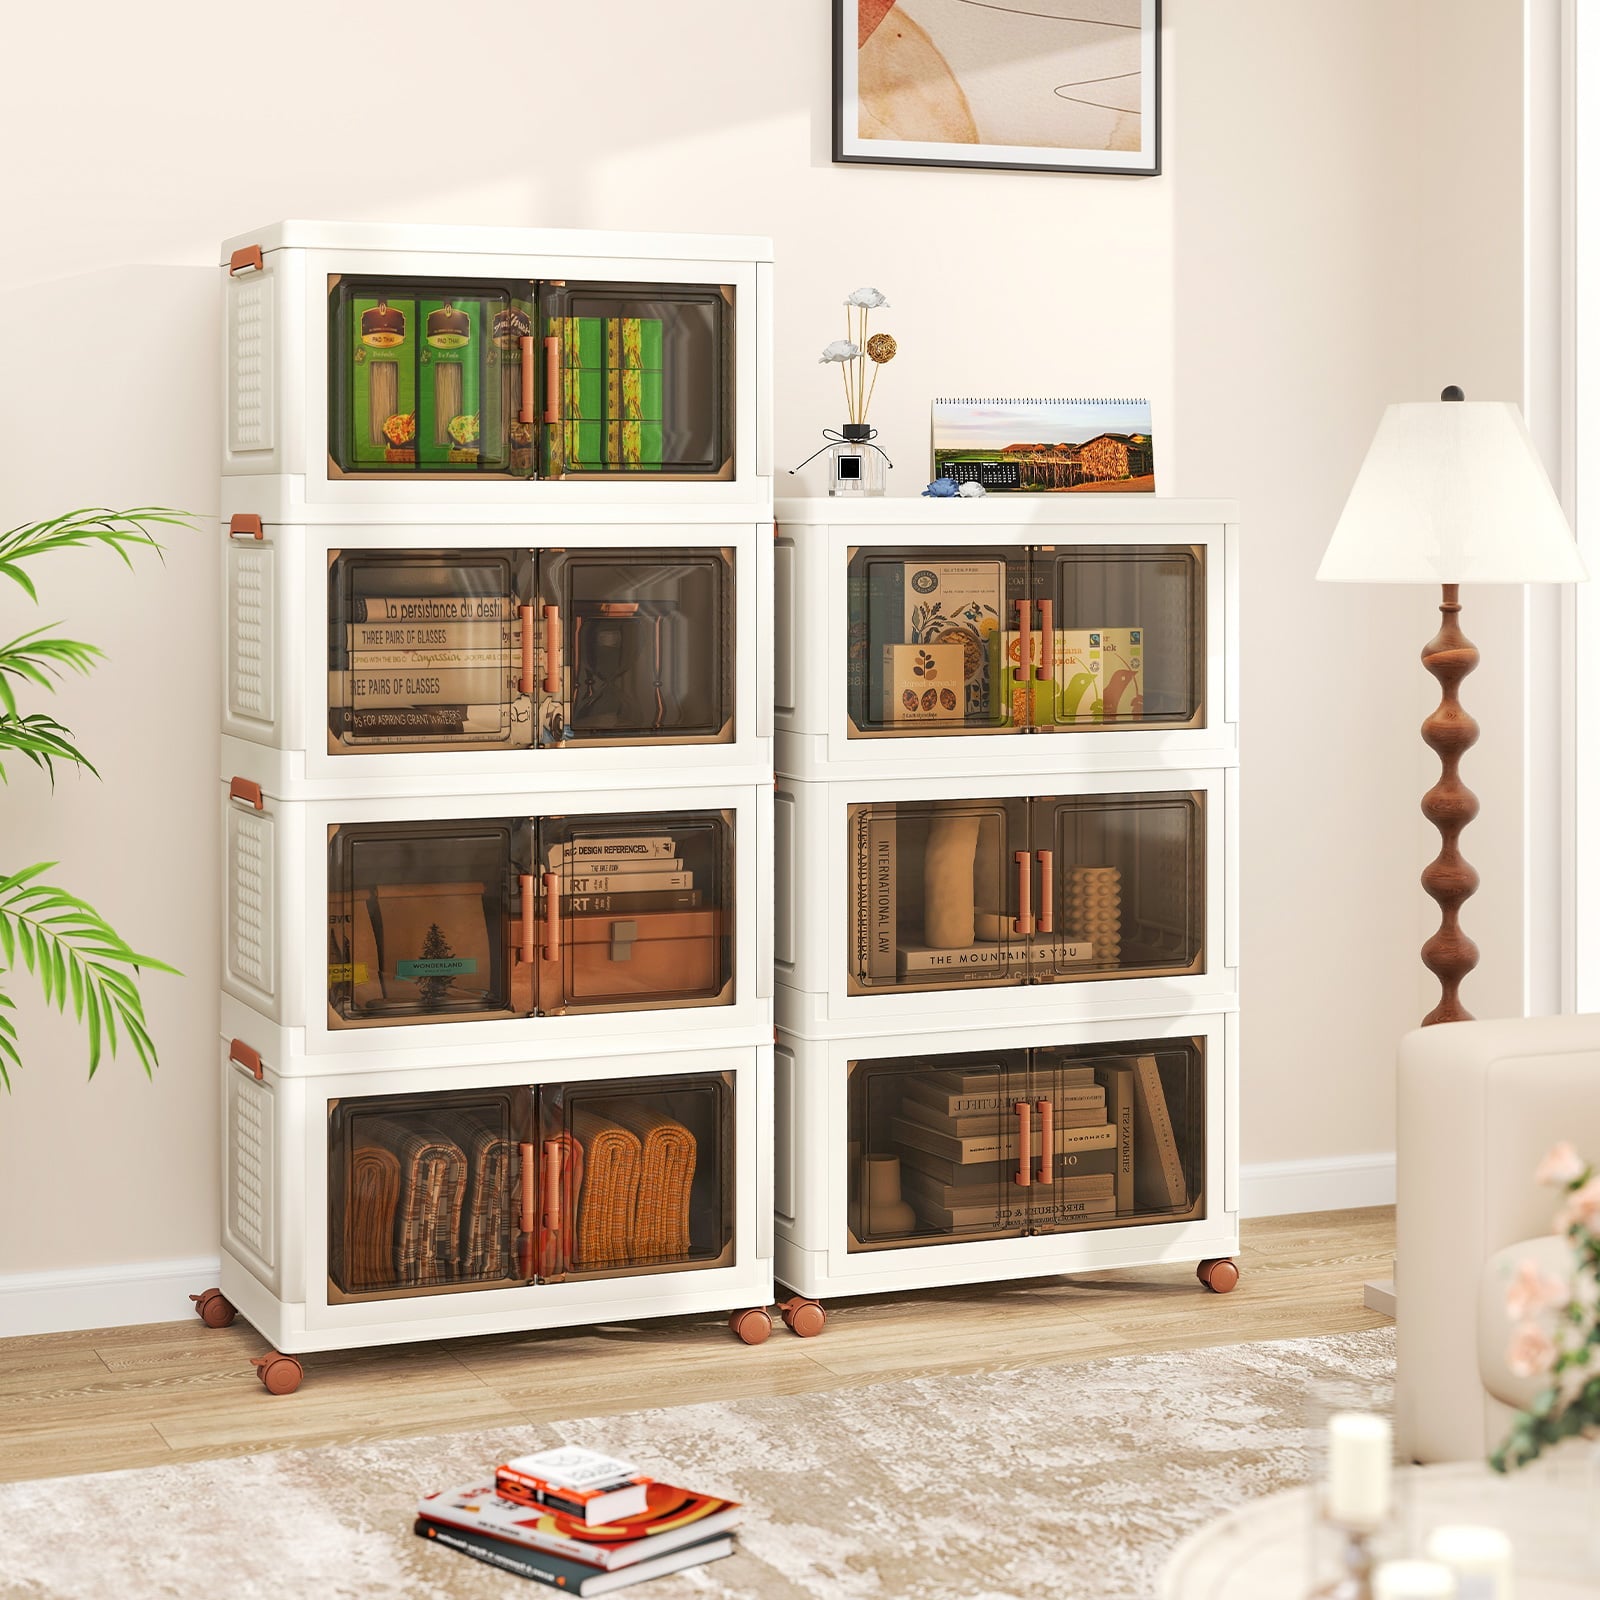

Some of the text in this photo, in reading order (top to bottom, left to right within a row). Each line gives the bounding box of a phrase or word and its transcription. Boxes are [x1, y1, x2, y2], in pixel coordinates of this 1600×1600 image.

[384, 598, 398, 619] La
[400, 598, 457, 623] persistance
[460, 598, 473, 618] du
[361, 630, 384, 645] THREE
[385, 630, 404, 645] PAIRS
[406, 630, 415, 644] OF
[417, 629, 447, 644] GLASSES
[368, 679, 391, 695] PAIRS
[393, 678, 403, 695] OF
[405, 678, 440, 694] GLASSES
[377, 713, 406, 725] ASPIRING
[406, 713, 429, 725] GRANT
[578, 845, 603, 855] DESIGN
[878, 840, 890, 953] INTERNATIONAL LAW
[930, 955, 952, 965] THE
